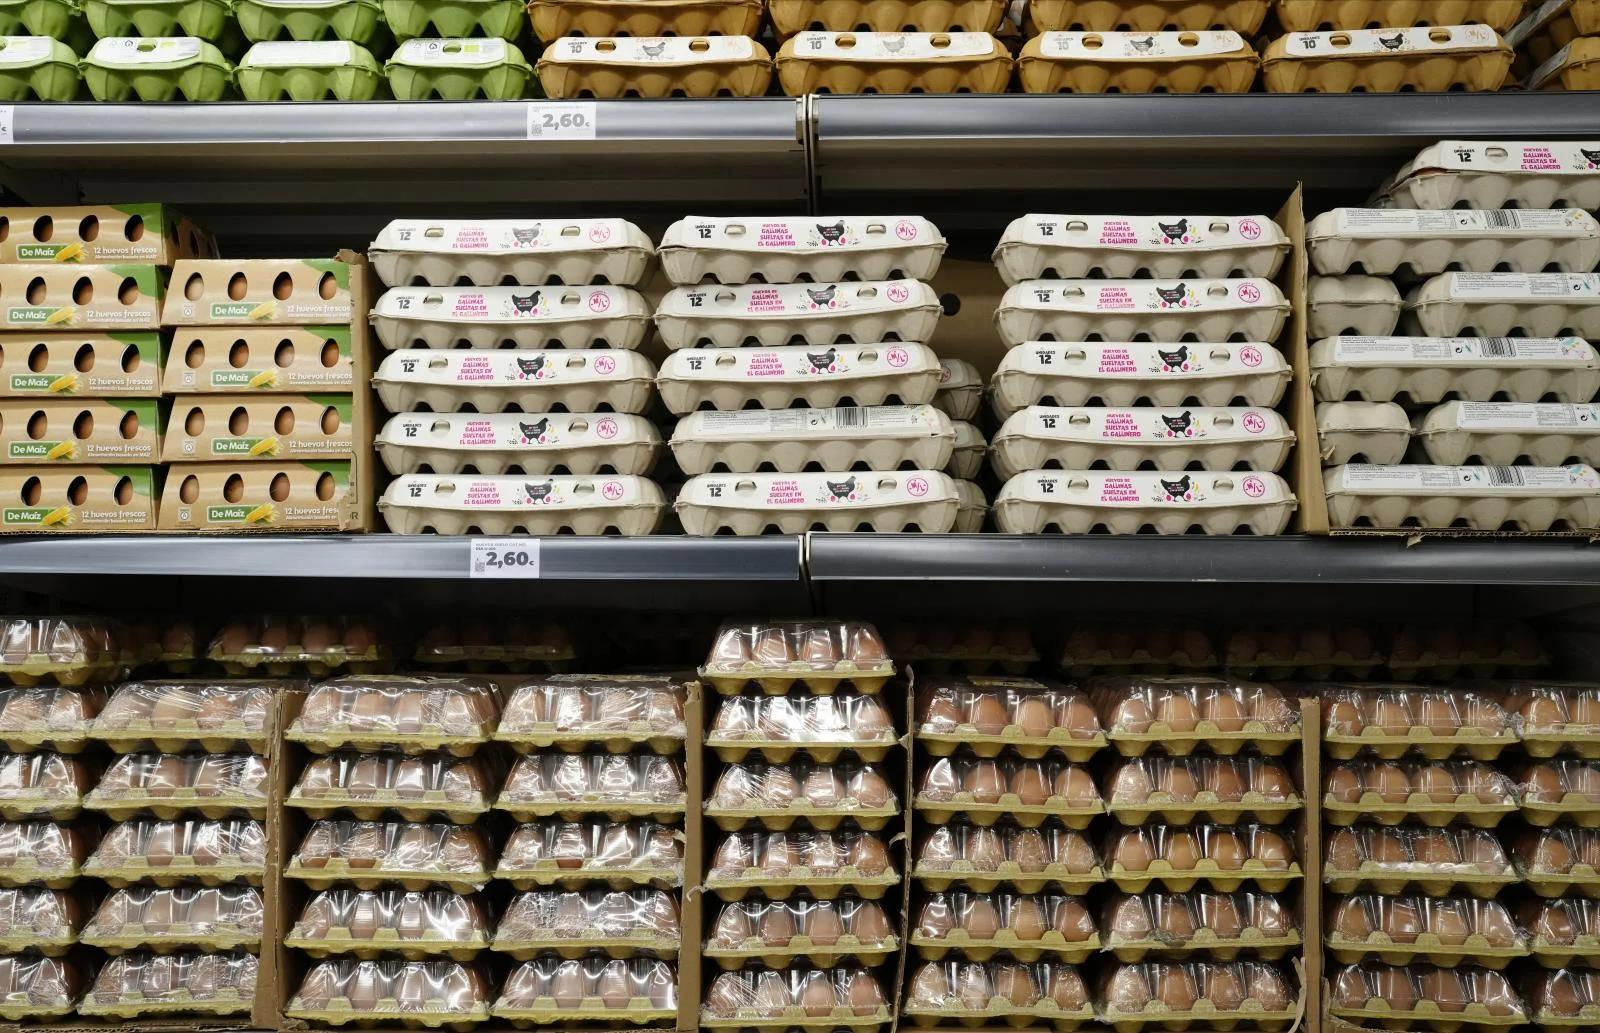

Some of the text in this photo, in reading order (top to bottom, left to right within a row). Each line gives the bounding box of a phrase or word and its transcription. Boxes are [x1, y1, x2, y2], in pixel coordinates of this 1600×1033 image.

[570, 45, 582, 53] 10
[810, 41, 822, 50] 10
[1057, 41, 1068, 50] 10
[1302, 40, 1316, 49] 10
[1458, 153, 1471, 162] 12
[699, 229, 711, 238] 12
[1041, 227, 1053, 235] 12
[400, 232, 411, 240] 12
[690, 298, 702, 306] 12
[1038, 294, 1050, 302] 12
[399, 300, 410, 309] 12
[1039, 355, 1051, 364] 12
[403, 363, 414, 372] 12
[690, 361, 702, 370] 12
[1043, 419, 1055, 428] 12
[406, 428, 417, 436] 12
[410, 488, 421, 497] 12
[710, 488, 721, 497] 12
[1041, 484, 1053, 492] 12
